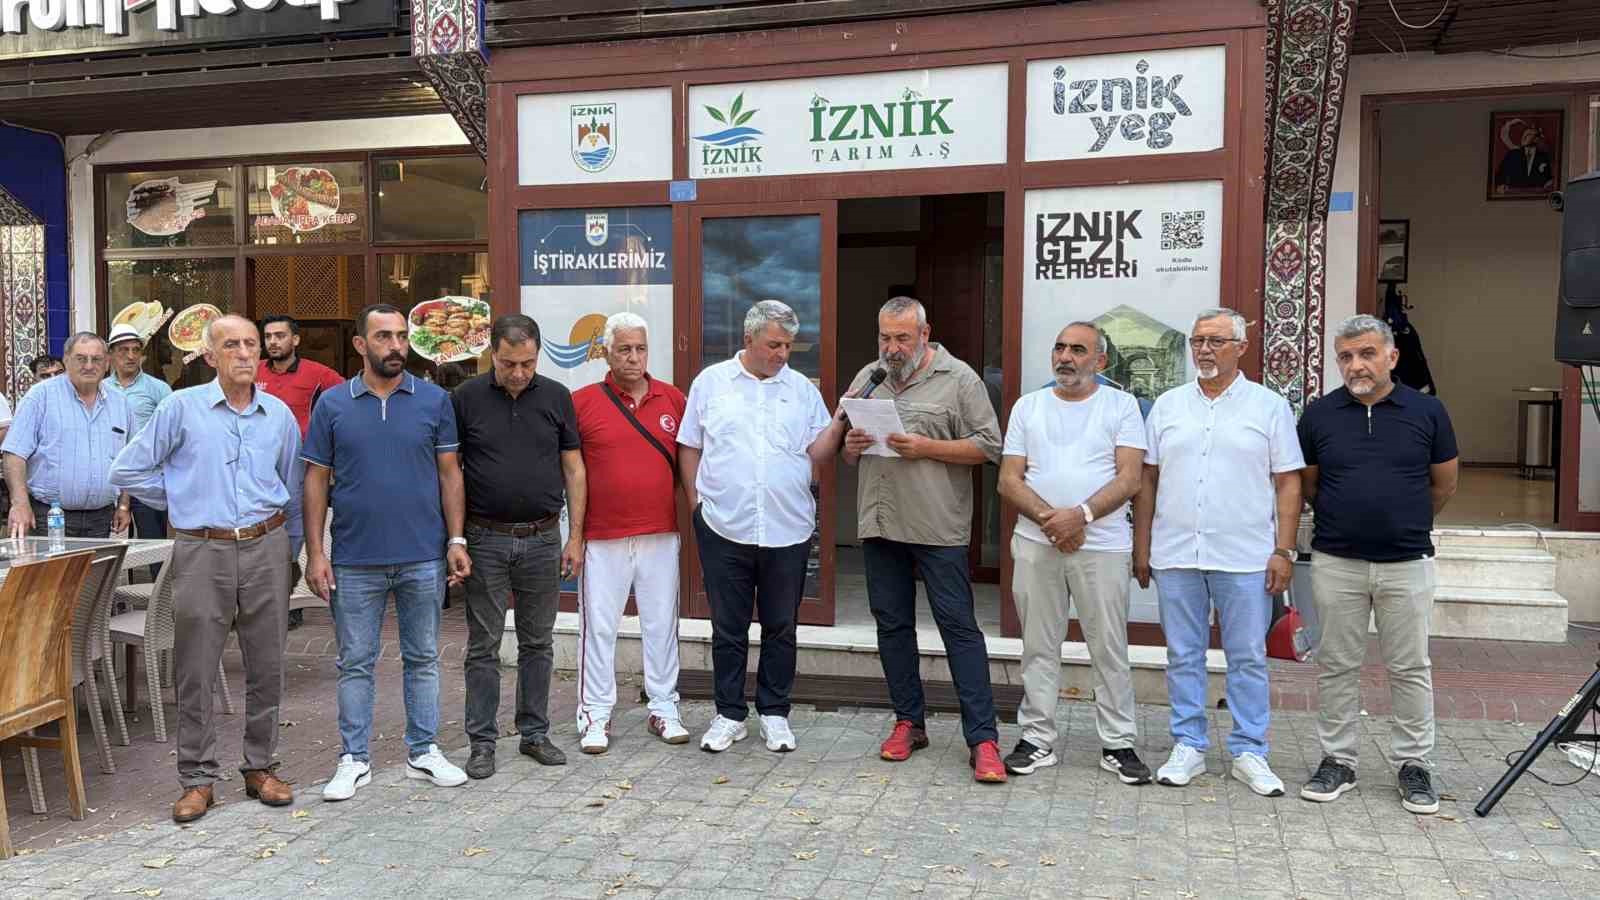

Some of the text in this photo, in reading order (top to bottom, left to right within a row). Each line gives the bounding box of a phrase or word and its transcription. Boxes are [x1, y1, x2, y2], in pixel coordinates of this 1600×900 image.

[809, 90, 954, 142] İZNİK
[1088, 111, 1176, 152] yeg
[703, 144, 763, 166] İZNİK
[812, 145, 893, 162] TARIM
[533, 248, 666, 275] İŞTİRAKLERİMİZ
